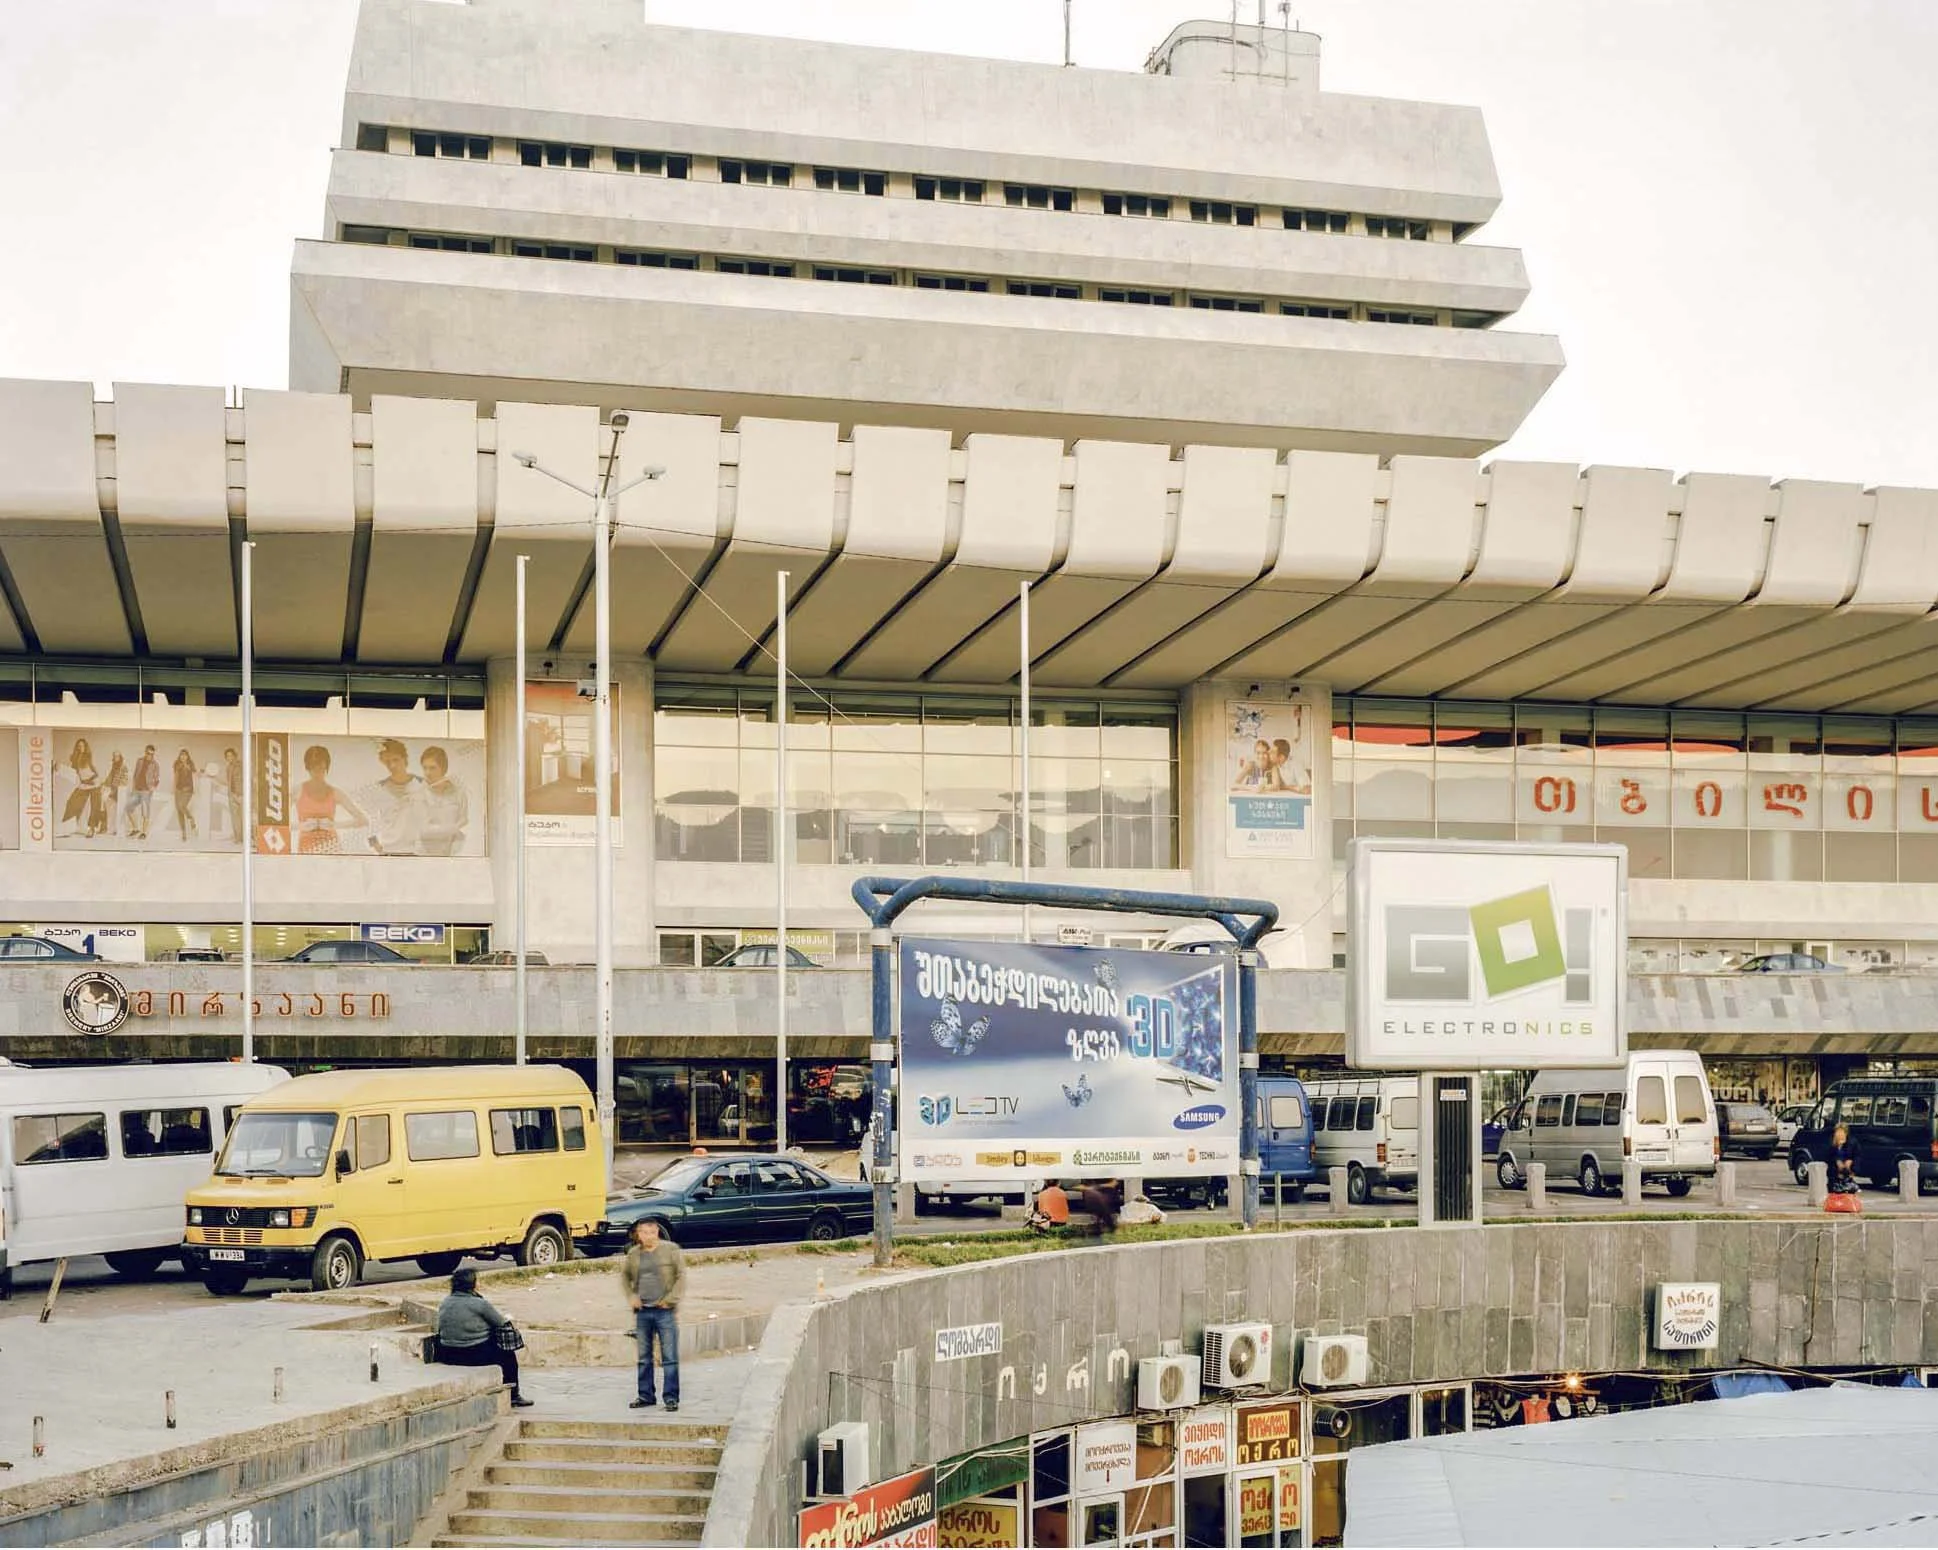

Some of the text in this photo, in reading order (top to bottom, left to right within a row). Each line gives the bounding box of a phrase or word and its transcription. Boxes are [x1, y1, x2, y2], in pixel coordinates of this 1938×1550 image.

[26, 736, 44, 842] collezione
[265, 738, 283, 822] lotto
[98, 929, 137, 937] BEKO
[369, 926, 436, 941] BEKO
[914, 950, 1120, 1019] შთაბეჭდილებათა
[1127, 993, 1177, 1059] 3D
[1383, 1021, 1593, 1036] ELECTRONICS
[1065, 1028, 1121, 1062] ზღვა
[1180, 1111, 1220, 1123] SAMSUNG
[936, 1326, 1001, 1358] ლომბარდი
[998, 1348, 1130, 1401] ოქრო
[1185, 1422, 1225, 1443] ვიყიდი
[1185, 1446, 1224, 1467] ოქროს
[1238, 1439, 1299, 1464] ოქრო
[1242, 1511, 1296, 1533] ვერცლი
